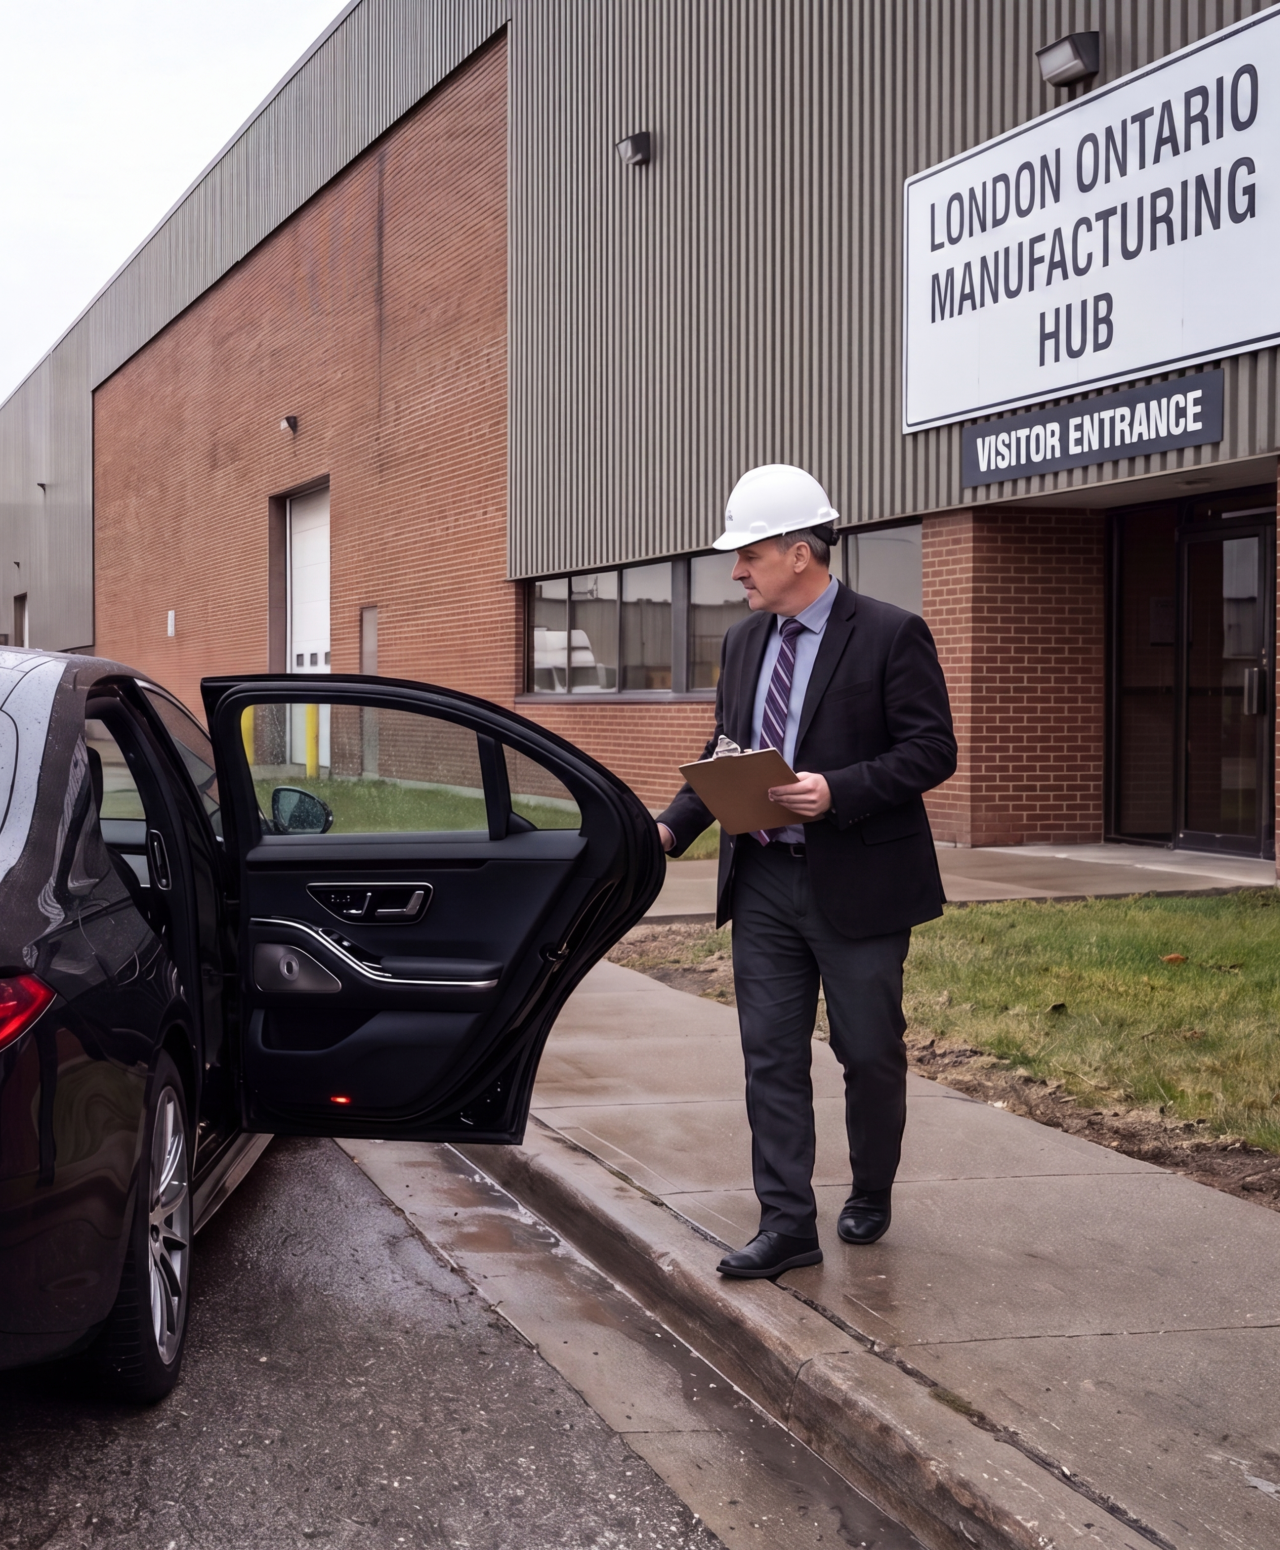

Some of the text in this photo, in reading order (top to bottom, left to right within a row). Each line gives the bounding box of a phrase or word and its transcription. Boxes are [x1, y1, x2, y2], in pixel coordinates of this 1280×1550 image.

[930, 63, 1259, 253] LONDON ONTARIO
[931, 156, 1257, 324] MANUFACTURING
[1039, 292, 1114, 367] HUB
[976, 389, 1203, 472] VISITOR ENTRANCE
